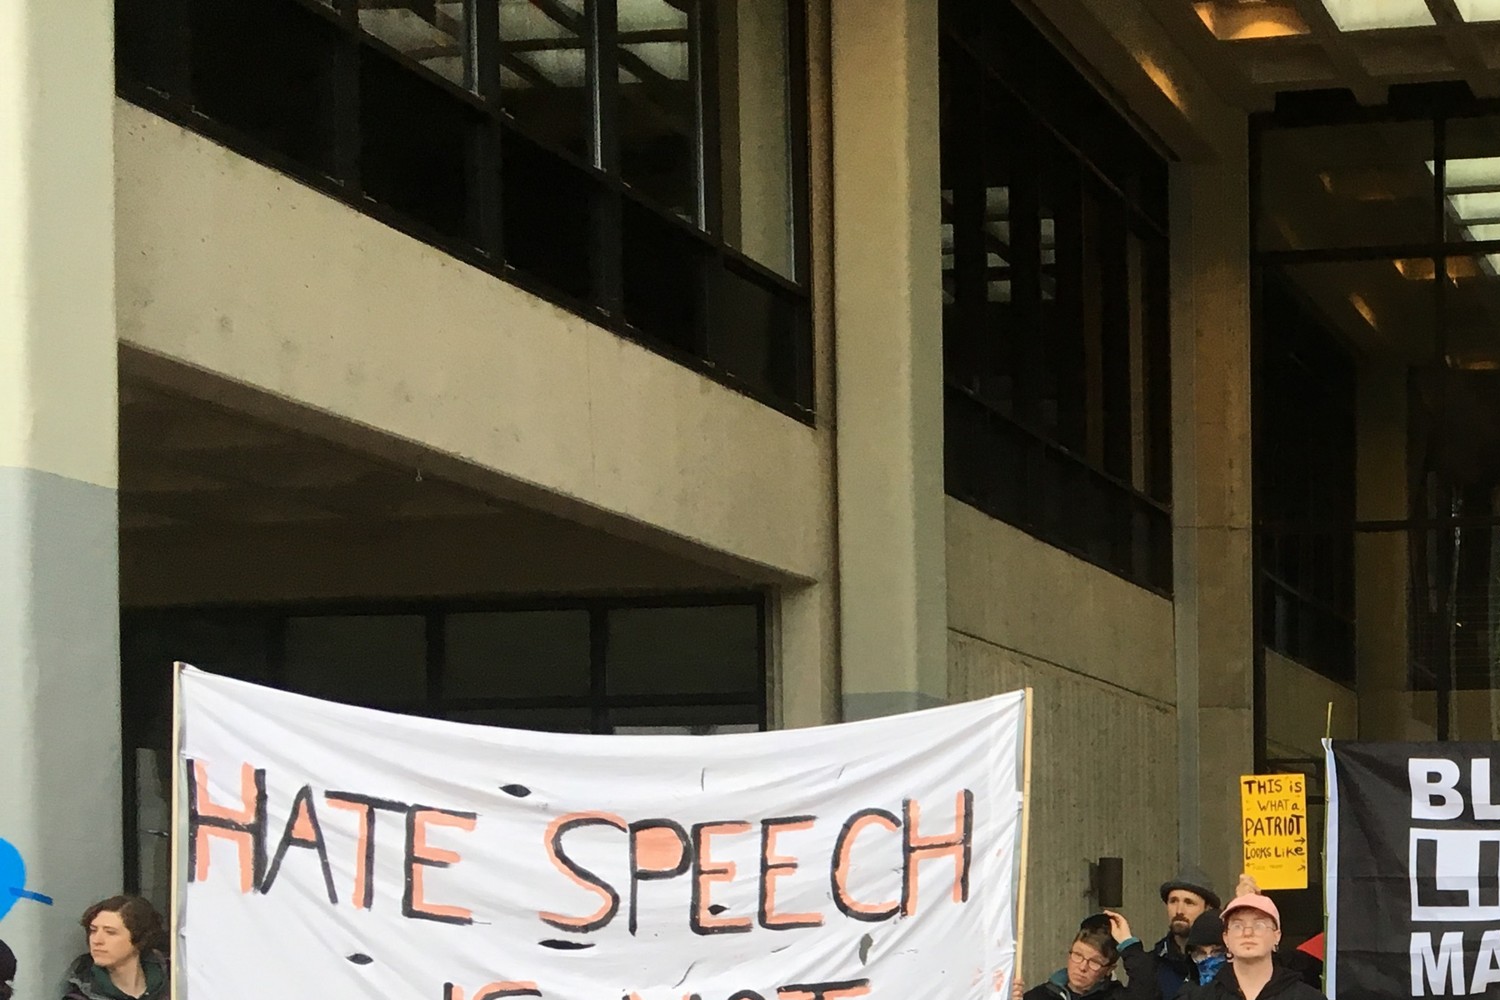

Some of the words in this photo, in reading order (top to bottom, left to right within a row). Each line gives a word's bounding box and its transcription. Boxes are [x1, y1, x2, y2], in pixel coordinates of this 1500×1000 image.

[1243, 779, 1283, 795] THIS
[1257, 799, 1290, 812] WHAT
[1244, 814, 1305, 838] PATRIOT
[187, 758, 478, 925] HATE
[538, 788, 974, 936] SPEECH
[1245, 846, 1272, 860] LOOKS
